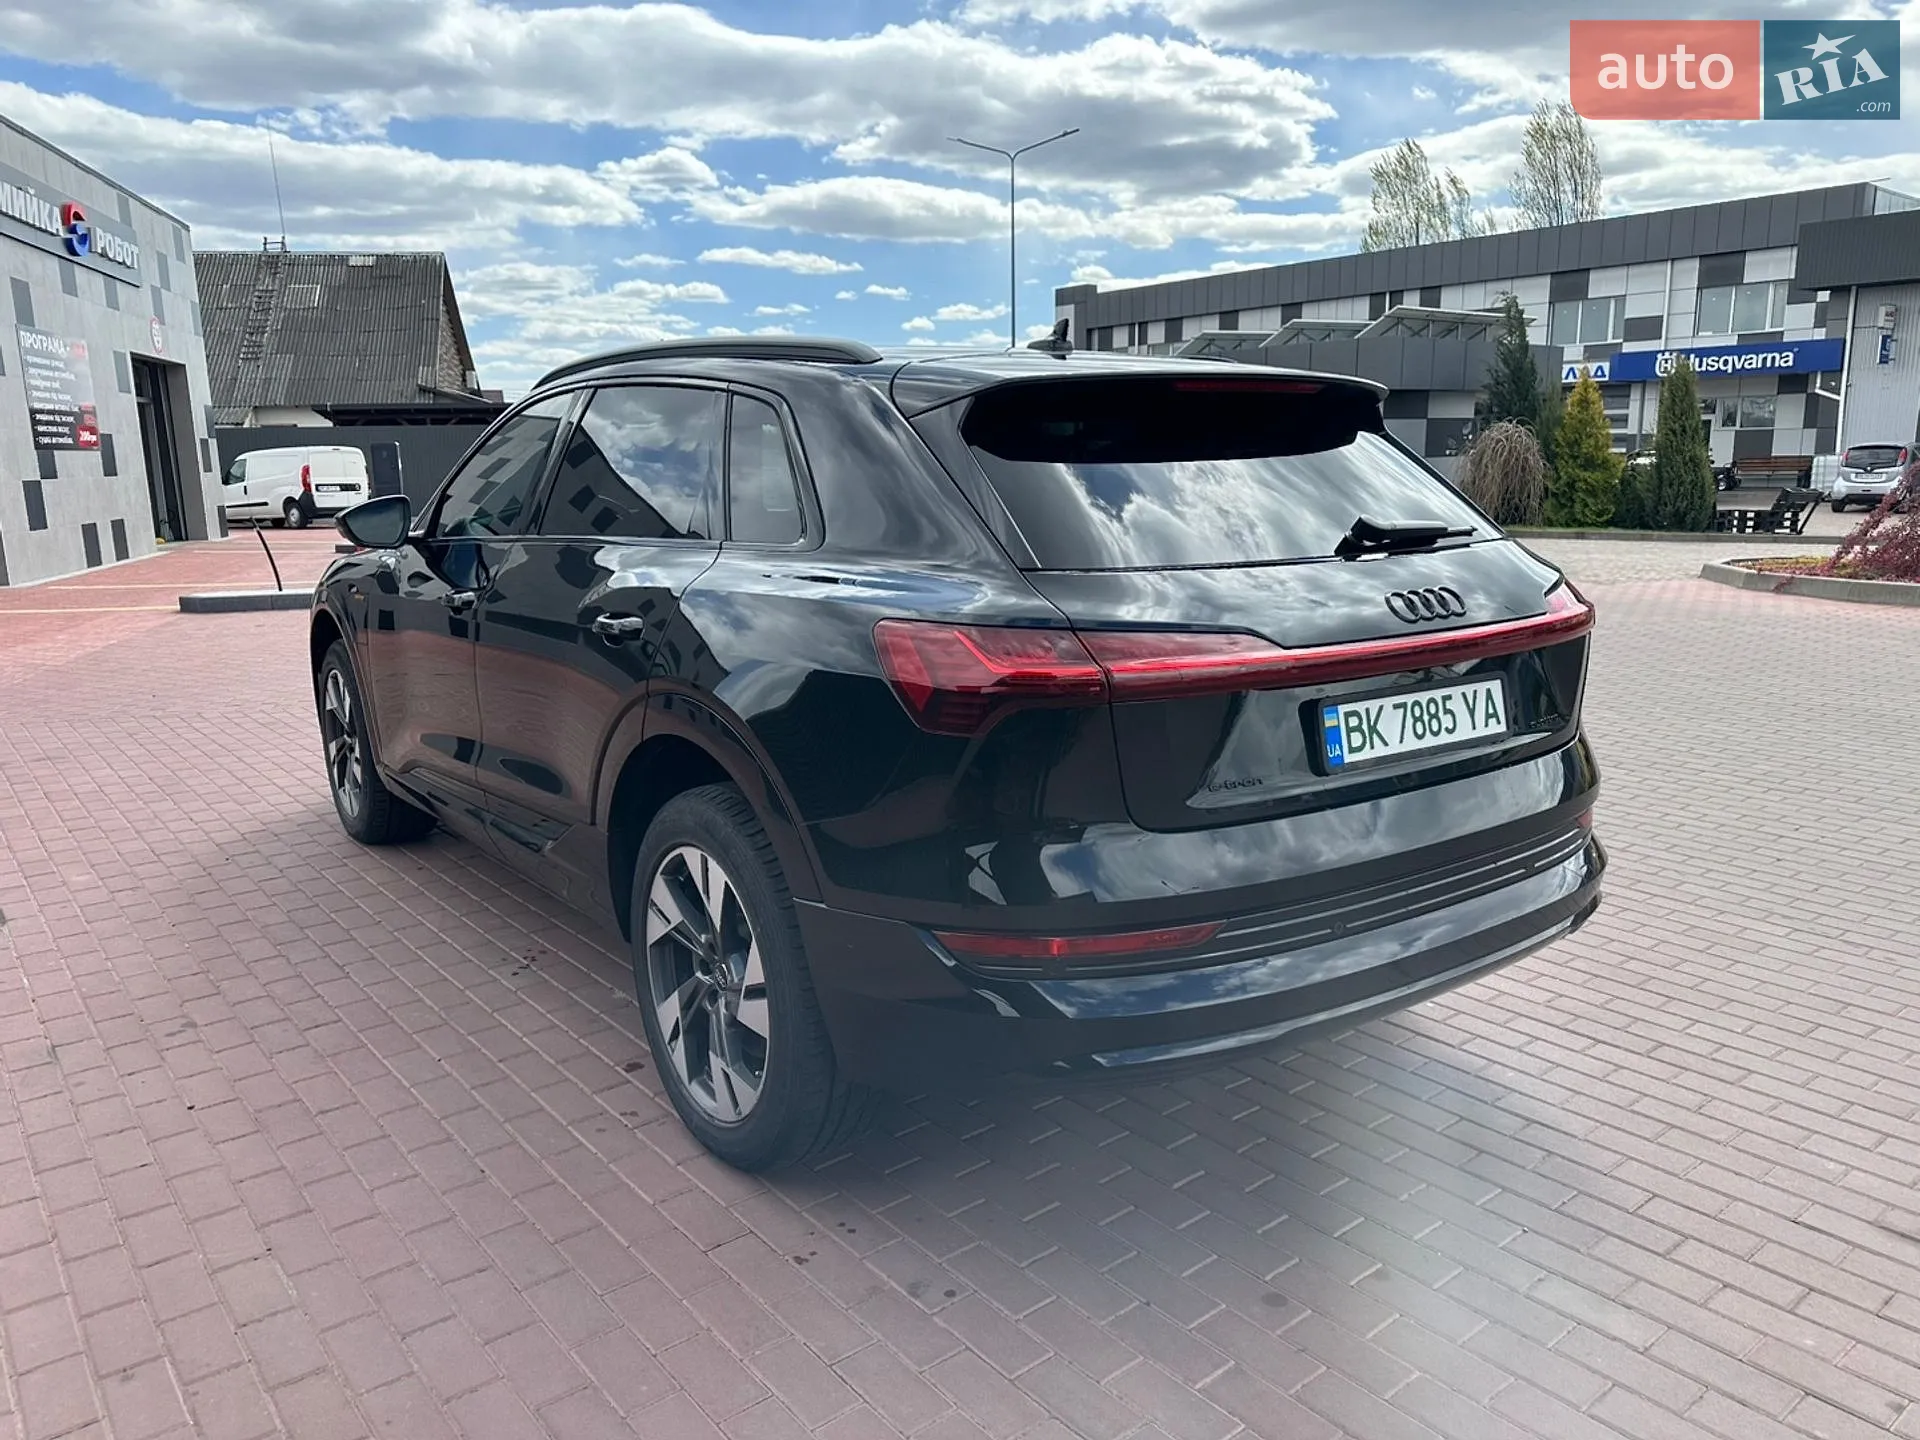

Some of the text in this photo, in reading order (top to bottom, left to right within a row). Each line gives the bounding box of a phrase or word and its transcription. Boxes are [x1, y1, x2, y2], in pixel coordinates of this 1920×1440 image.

[0, 180, 140, 269] МИЙКА РОБОТ
[1327, 743, 1342, 758] UA
[1343, 687, 1501, 755] BK 7885 YA
